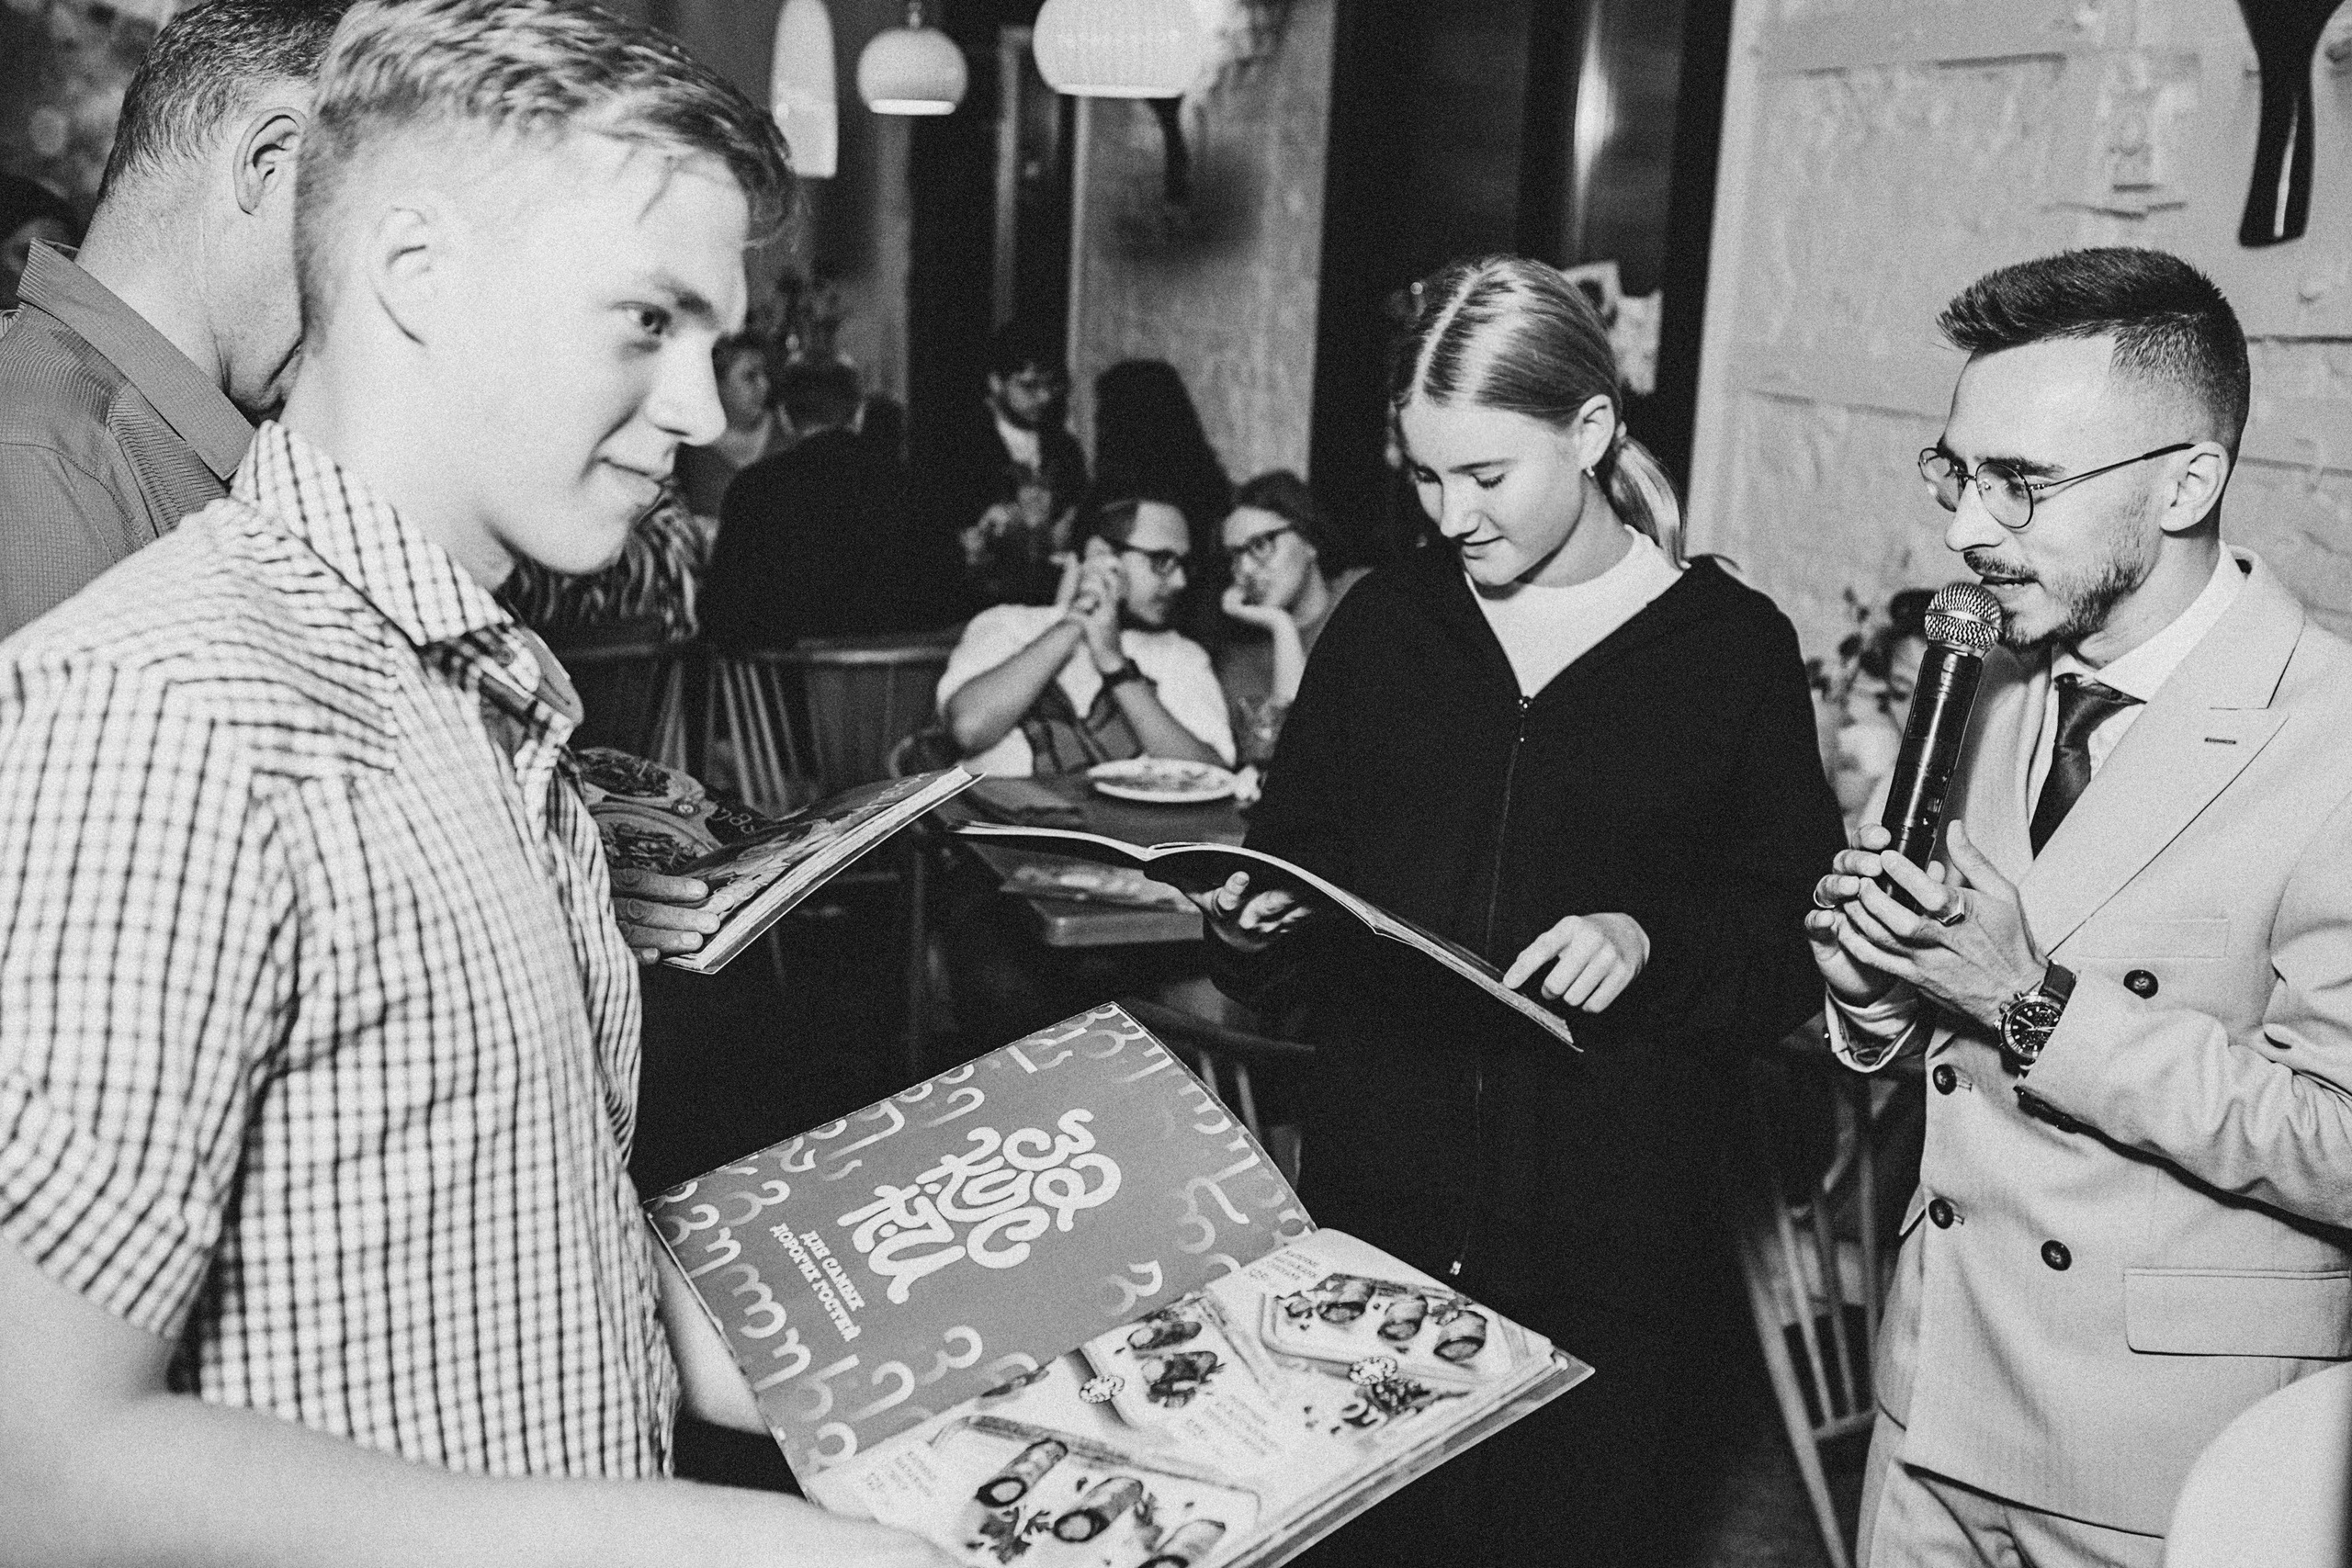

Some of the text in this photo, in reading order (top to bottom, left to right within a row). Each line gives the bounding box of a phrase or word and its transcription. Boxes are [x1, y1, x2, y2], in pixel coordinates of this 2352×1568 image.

[769, 1222, 862, 1342] ДОРОГИХ ГОСТЕЙ
[799, 1230, 865, 1312] ДЛЯ САМЫХ
